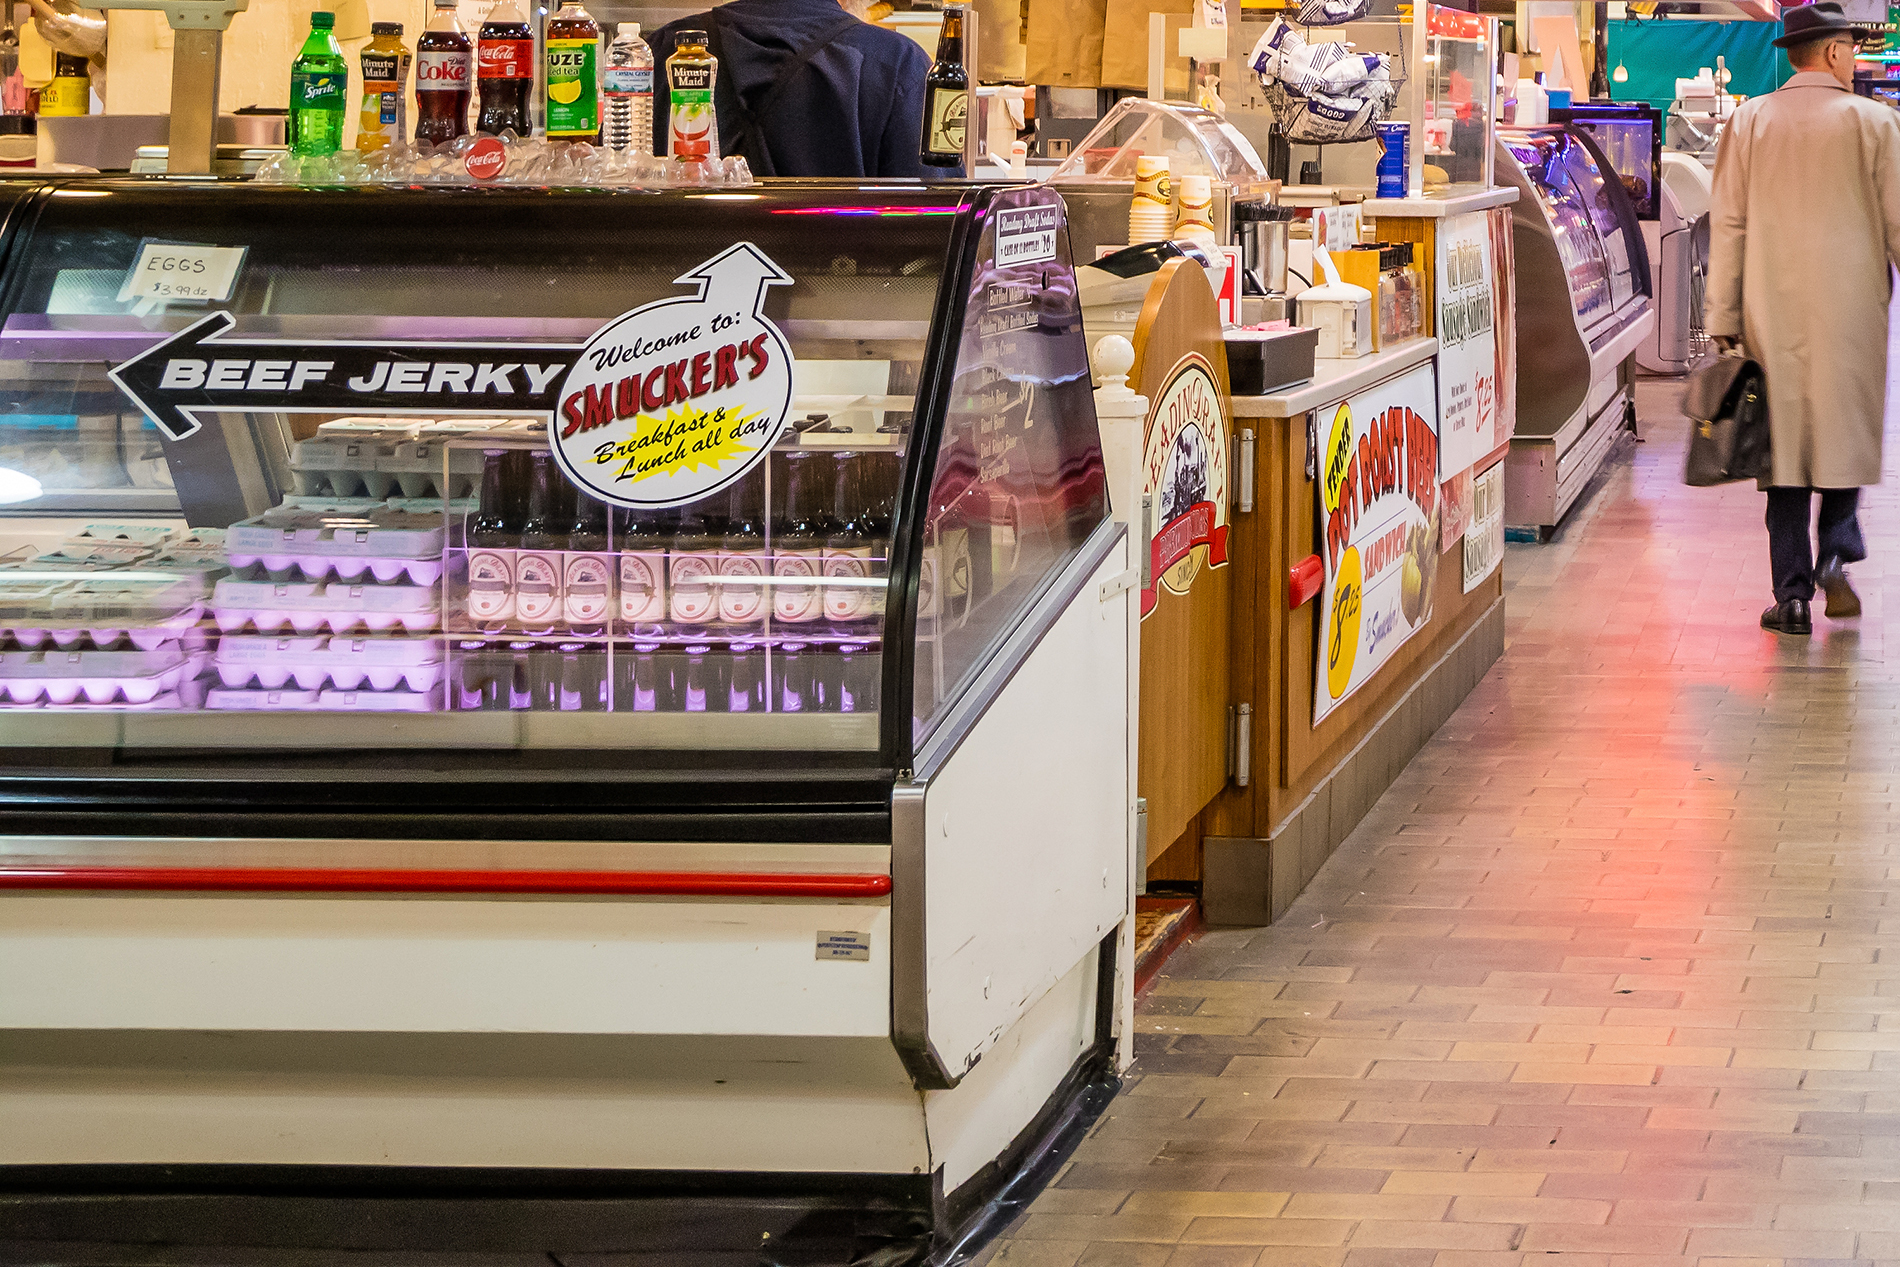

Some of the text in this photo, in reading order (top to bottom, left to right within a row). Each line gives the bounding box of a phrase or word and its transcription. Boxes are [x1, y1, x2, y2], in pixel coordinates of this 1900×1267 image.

[361, 58, 395, 69] Minute
[364, 68, 389, 78] Maid
[417, 59, 467, 81] Coke
[304, 84, 337, 99] Sprite
[146, 256, 207, 274] EGGS
[588, 309, 742, 374] Welcome to:
[159, 358, 568, 395] BEEF JERKY
[560, 332, 771, 438] SMUCKER'S
[593, 406, 728, 467] Breakfast &
[613, 414, 773, 484] Lunch all day
